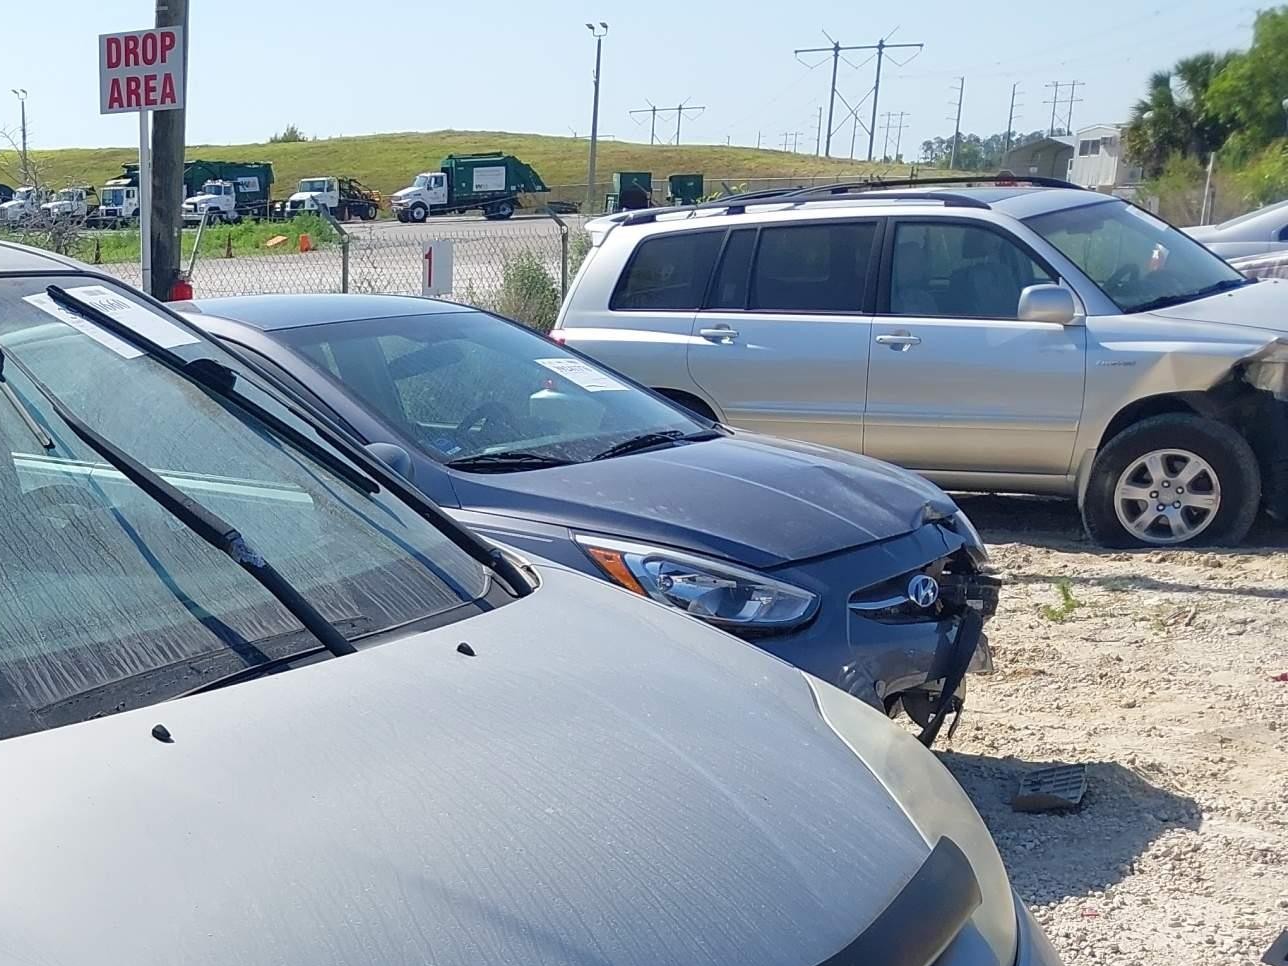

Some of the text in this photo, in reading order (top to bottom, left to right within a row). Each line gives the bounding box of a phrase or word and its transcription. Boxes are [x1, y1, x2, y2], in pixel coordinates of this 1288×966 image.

[106, 31, 176, 69] DROP
[108, 73, 176, 109] AREA
[424, 246, 433, 288] 1
